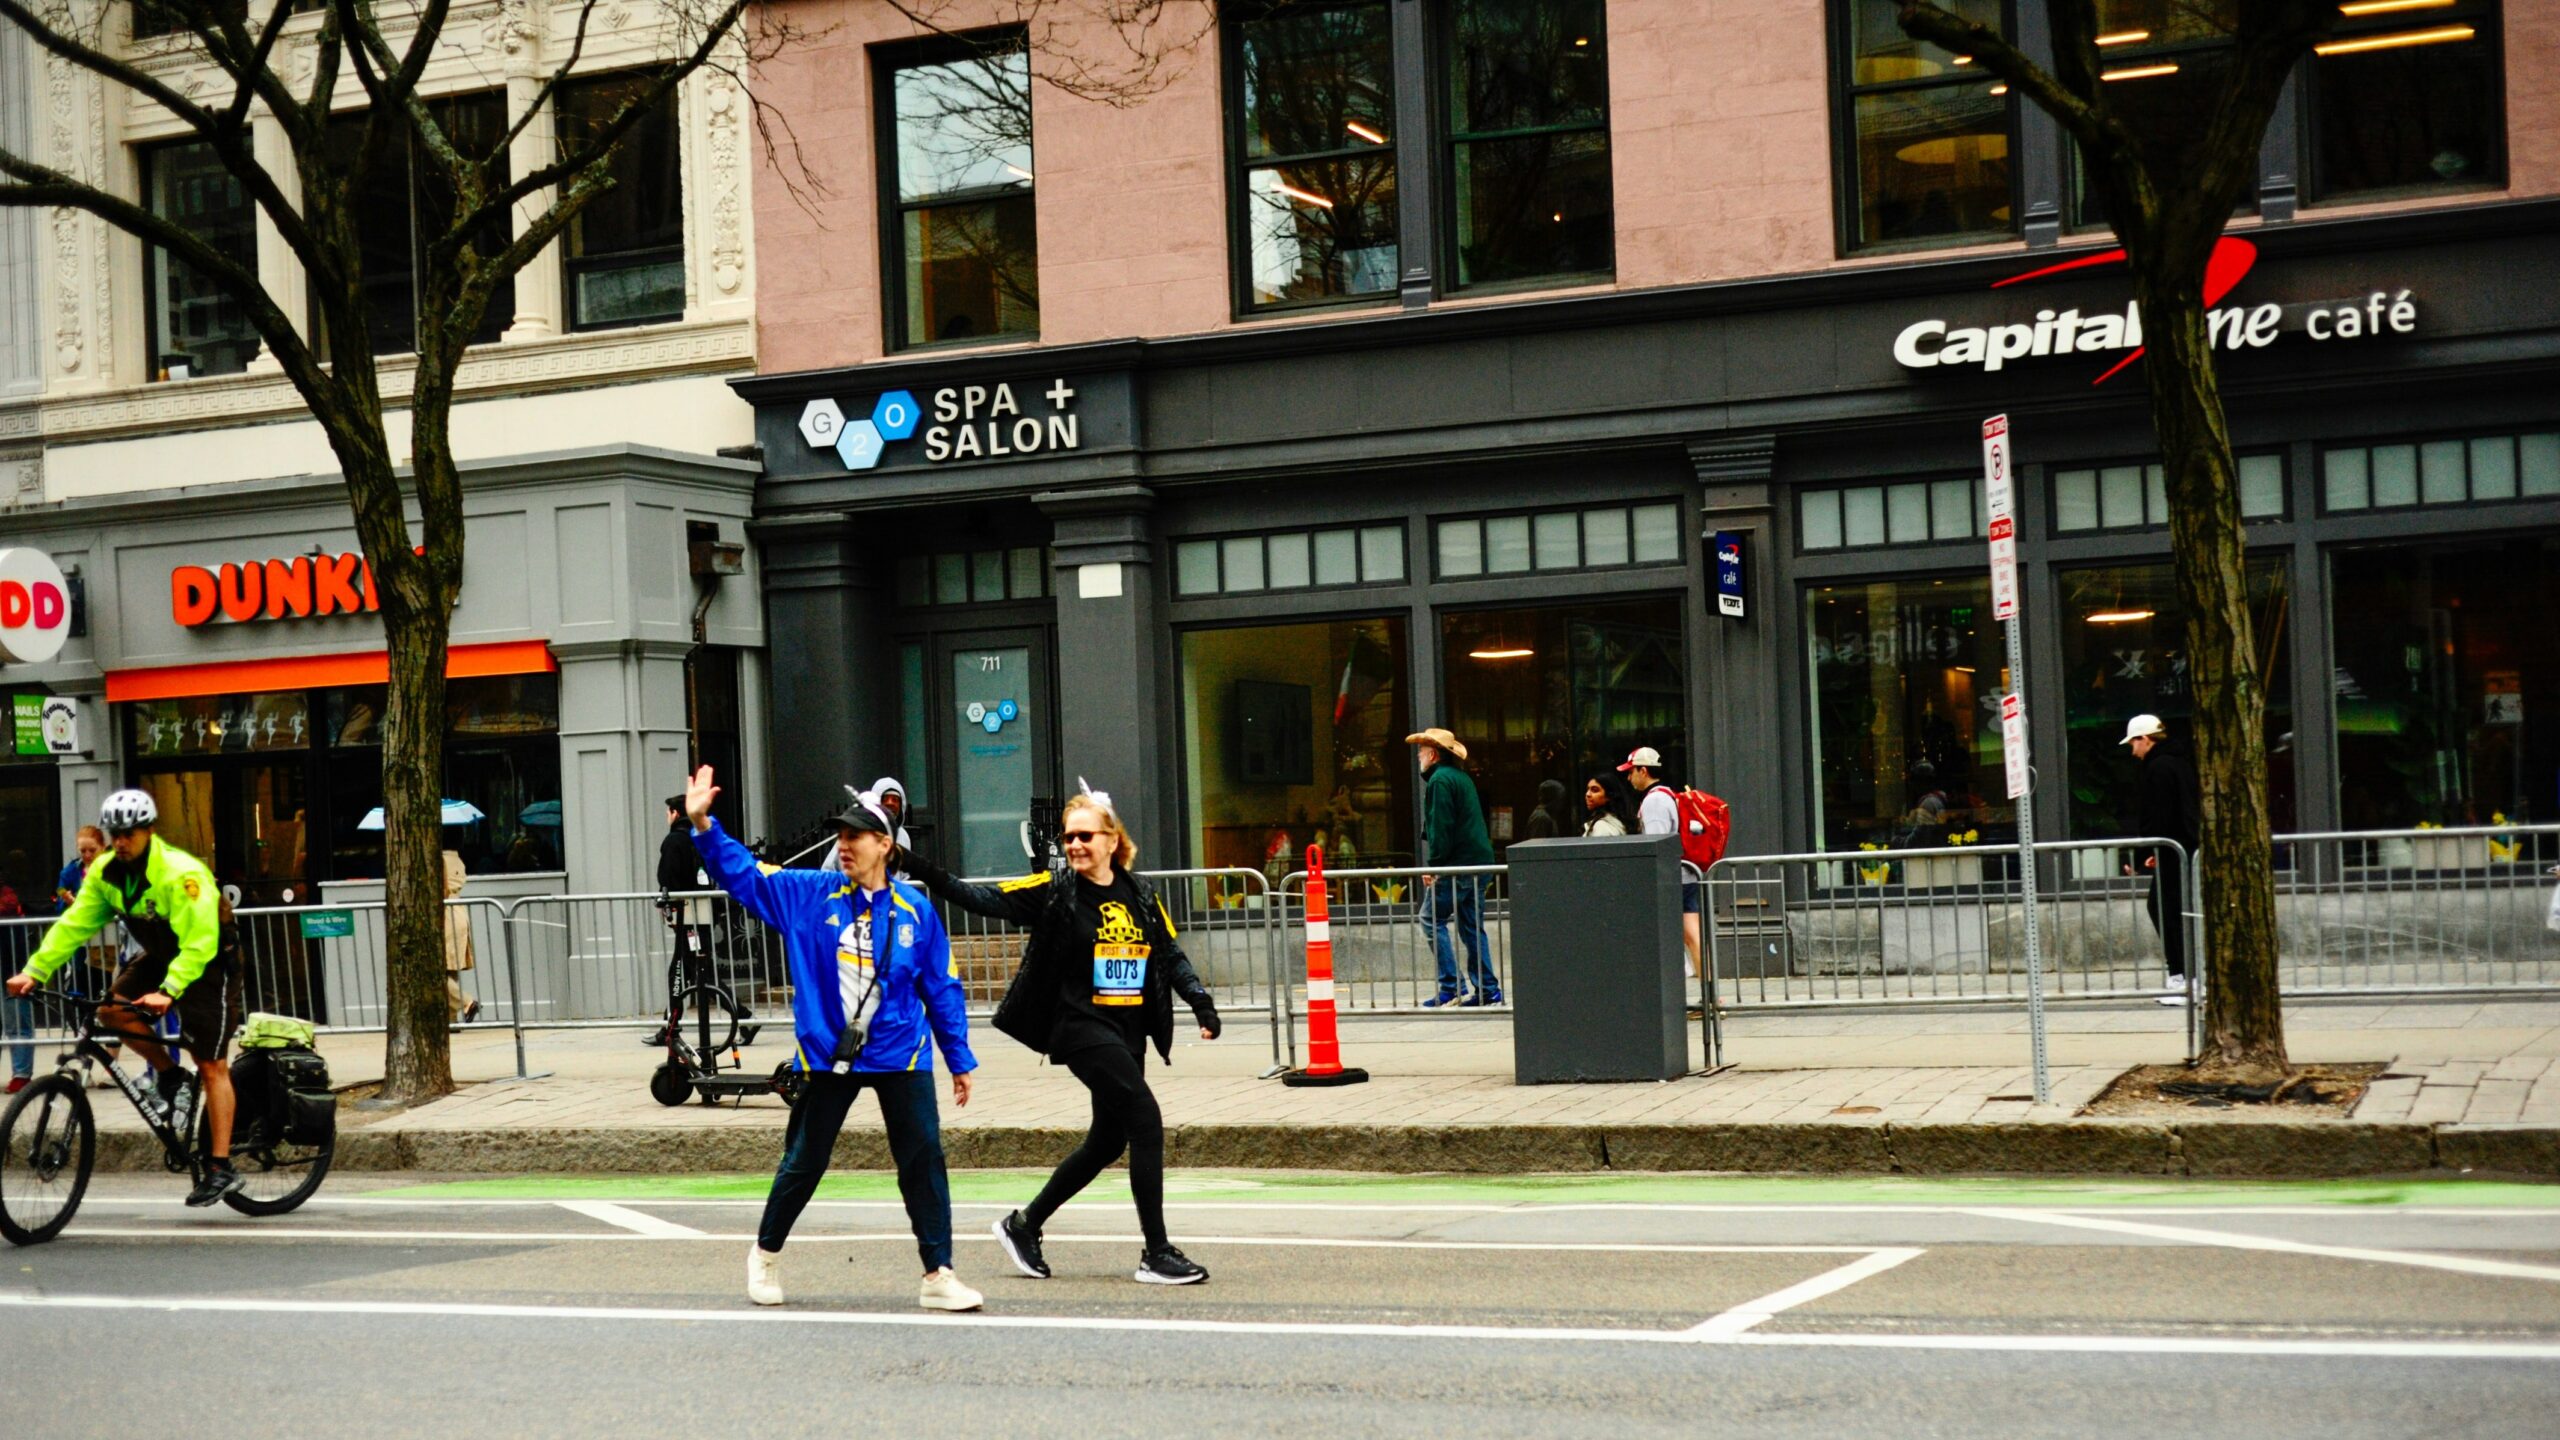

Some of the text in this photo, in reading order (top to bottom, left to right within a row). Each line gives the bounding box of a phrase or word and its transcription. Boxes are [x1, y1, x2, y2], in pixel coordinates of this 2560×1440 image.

[1893, 289, 2417, 371] Capital ne café
[934, 379, 1075, 423] SPA +
[925, 414, 1080, 461] SALON
[980, 656, 1001, 671] 711
[14, 706, 40, 716] NAILS
[1105, 959, 1138, 979] 8073
